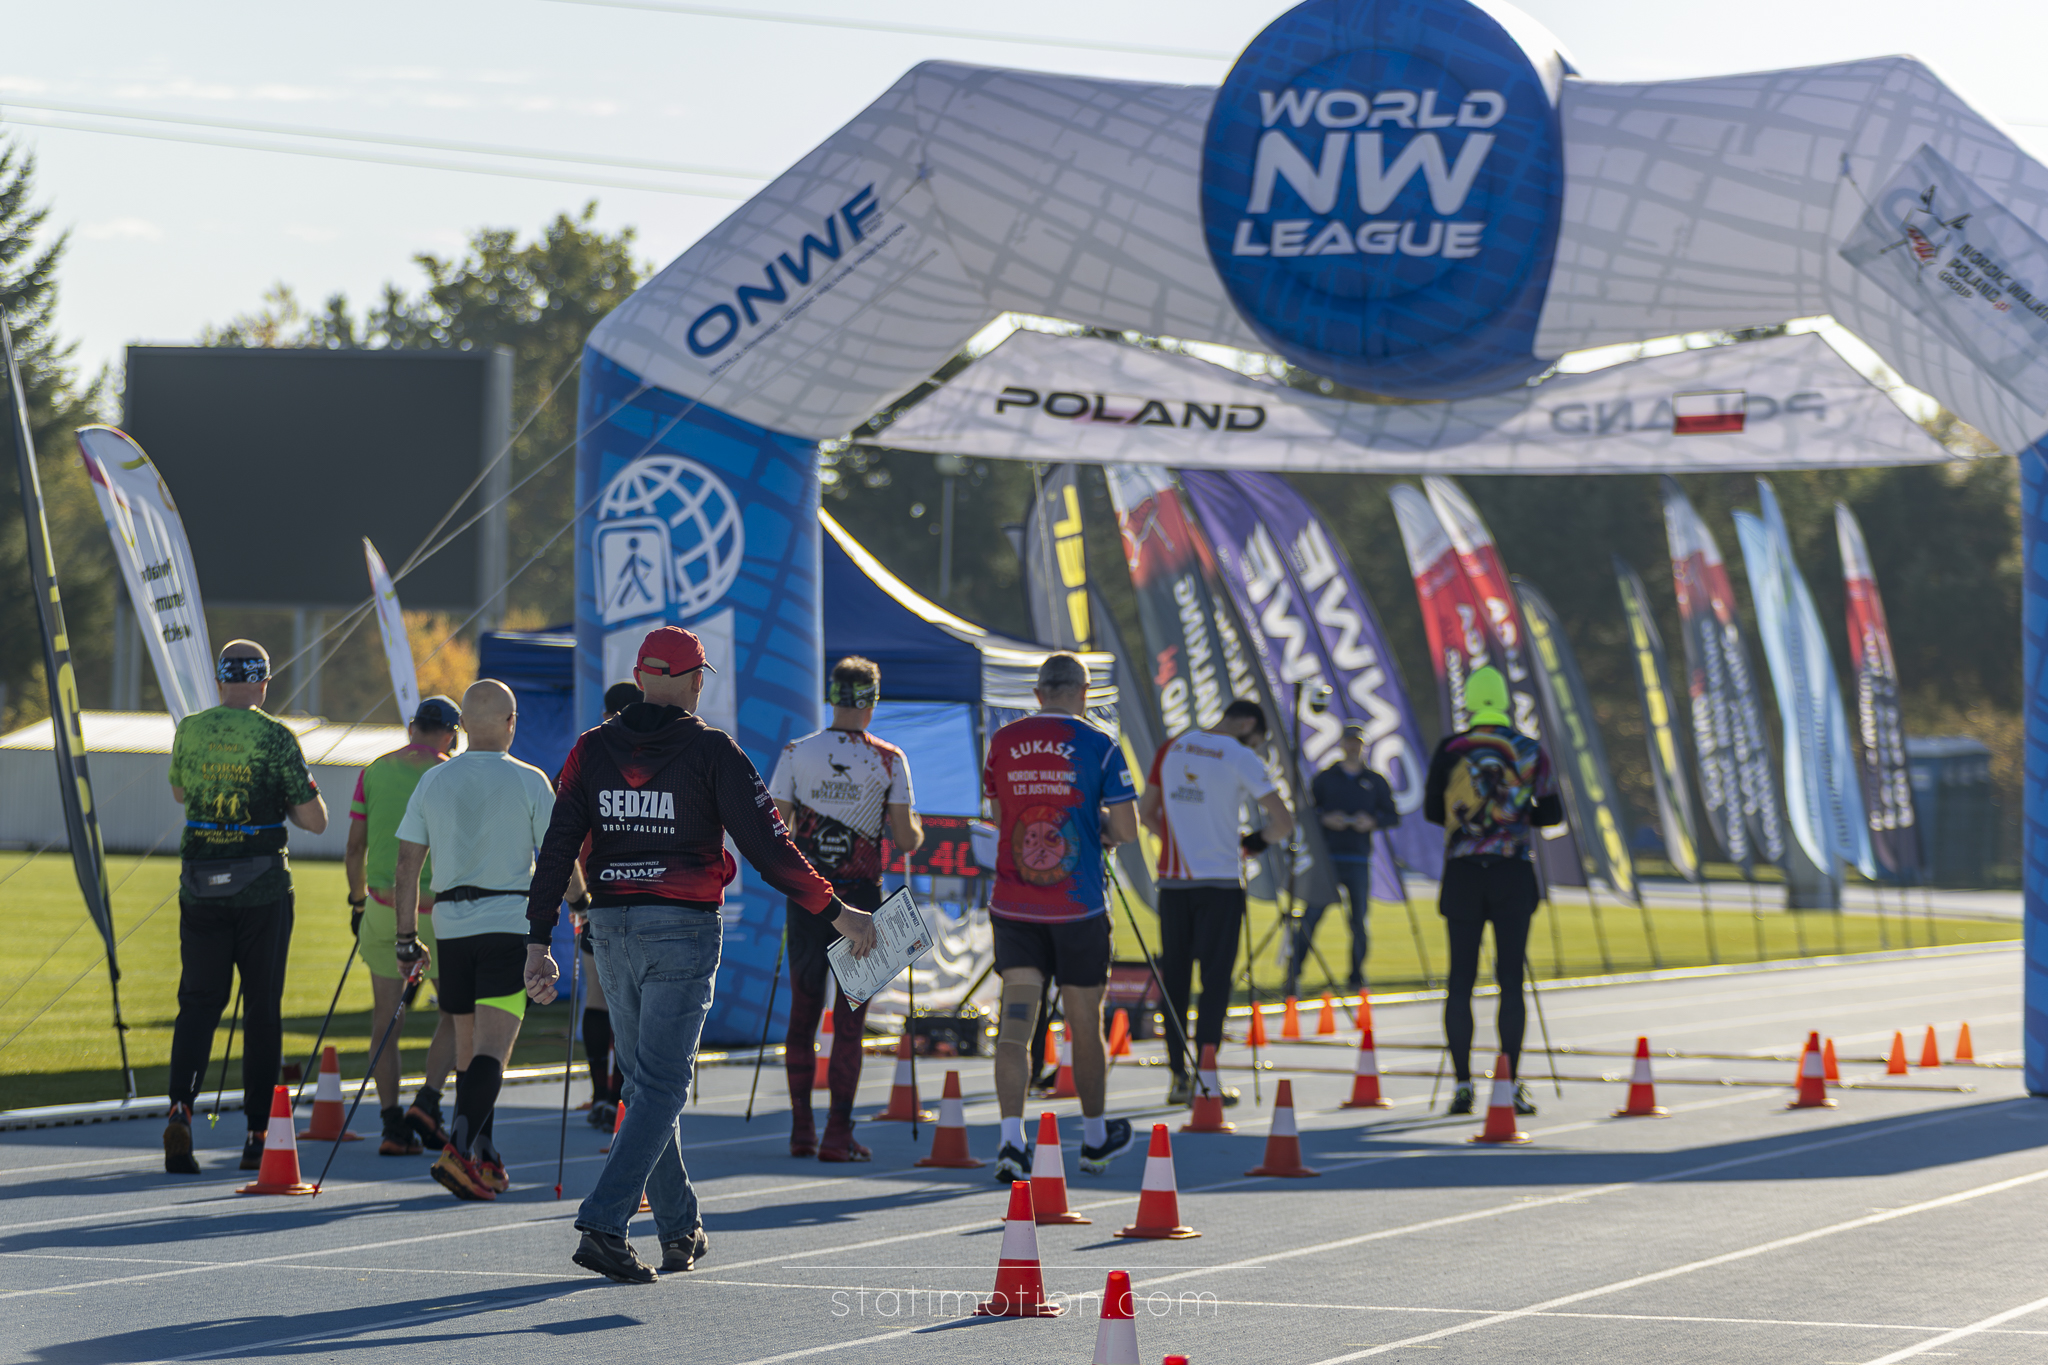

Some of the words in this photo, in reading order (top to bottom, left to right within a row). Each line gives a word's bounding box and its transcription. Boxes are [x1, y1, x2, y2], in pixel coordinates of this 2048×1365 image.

[1259, 89, 1507, 129] WORLD
[1246, 129, 1497, 215] NW
[1232, 219, 1487, 258] LEAGUE
[686, 182, 881, 358] ONWF
[1957, 243, 2012, 288] NORDIC
[996, 386, 1267, 431] POLAND
[1010, 740, 1076, 760] ŁUKASZ
[201, 763, 253, 776] FORMA
[1007, 770, 1038, 782] NORDIC
[1039, 770, 1077, 782] WALKING
[811, 789, 861, 801] WALKING
[821, 780, 864, 794] NORDIC
[1013, 784, 1027, 796] LZS
[1028, 783, 1071, 796] JUSTYNÓW
[598, 790, 675, 821] SĘDZIA
[599, 867, 667, 881] ONWF
